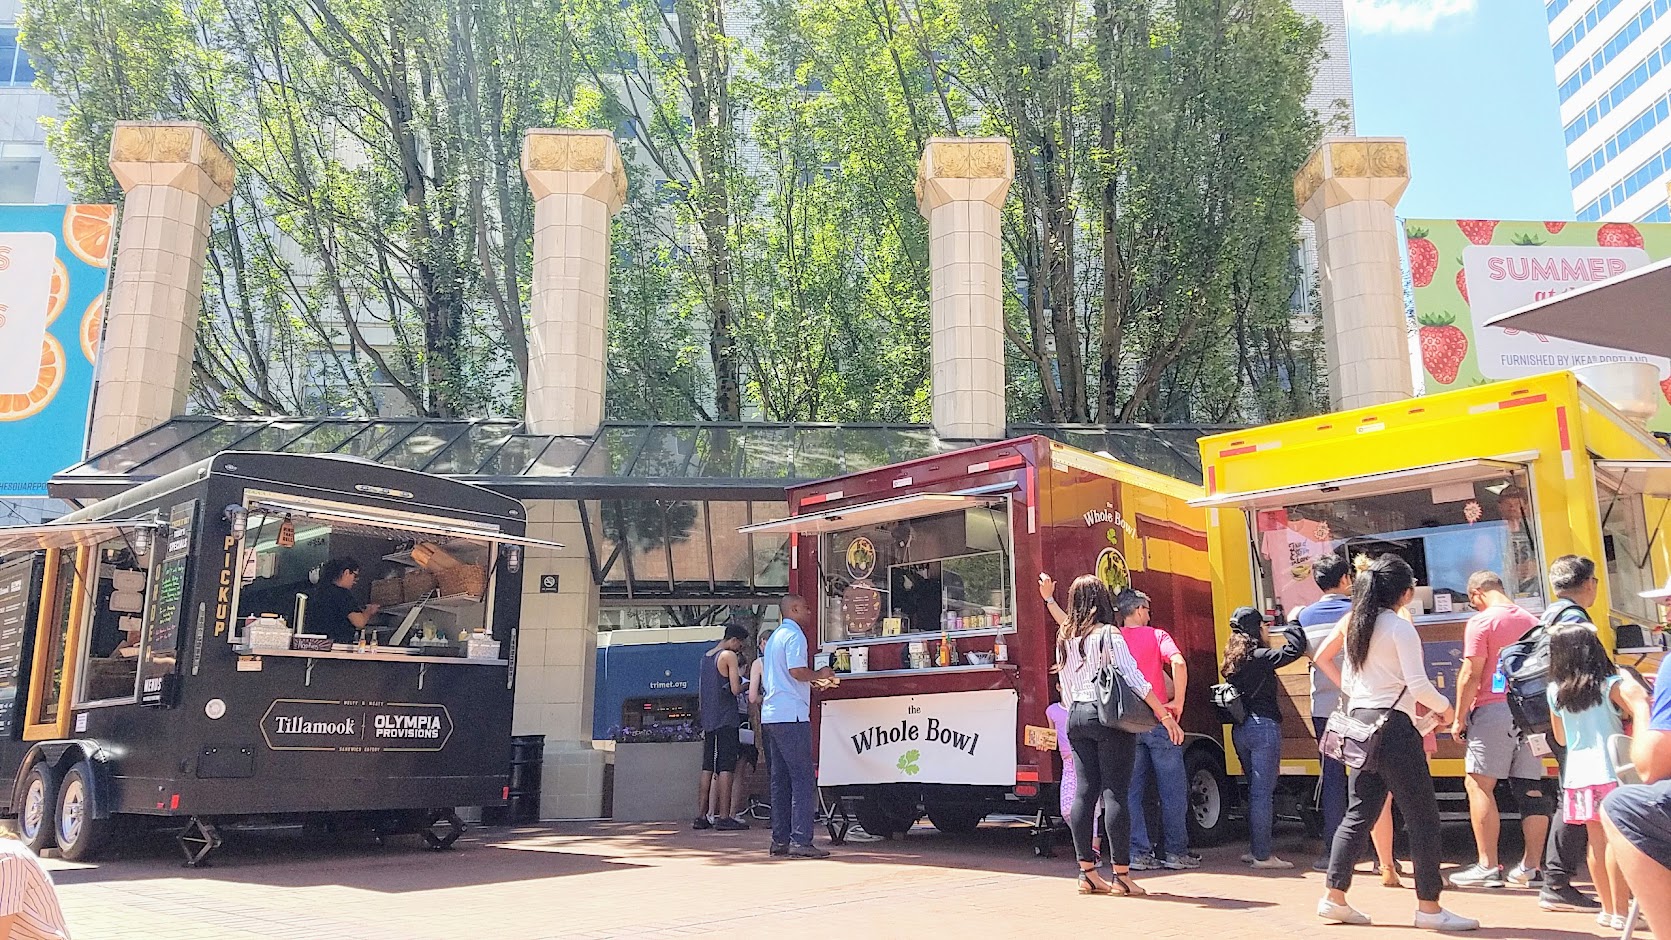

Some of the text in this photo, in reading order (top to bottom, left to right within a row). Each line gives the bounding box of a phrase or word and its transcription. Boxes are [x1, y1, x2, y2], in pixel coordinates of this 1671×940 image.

[1487, 257, 1627, 282] SUMMER
[1501, 355, 1557, 366] FURNISHED
[1558, 355, 1570, 366] BY
[1083, 508, 1137, 540] Whole Bowl
[213, 535, 236, 637] PICKUP
[650, 680, 687, 689] trimet.org
[907, 704, 922, 715] the
[275, 716, 355, 735] Tillamook
[374, 714, 441, 729] OLYMPIA
[375, 728, 439, 738] PROVISIONS
[850, 717, 980, 757] Whole Bowl
